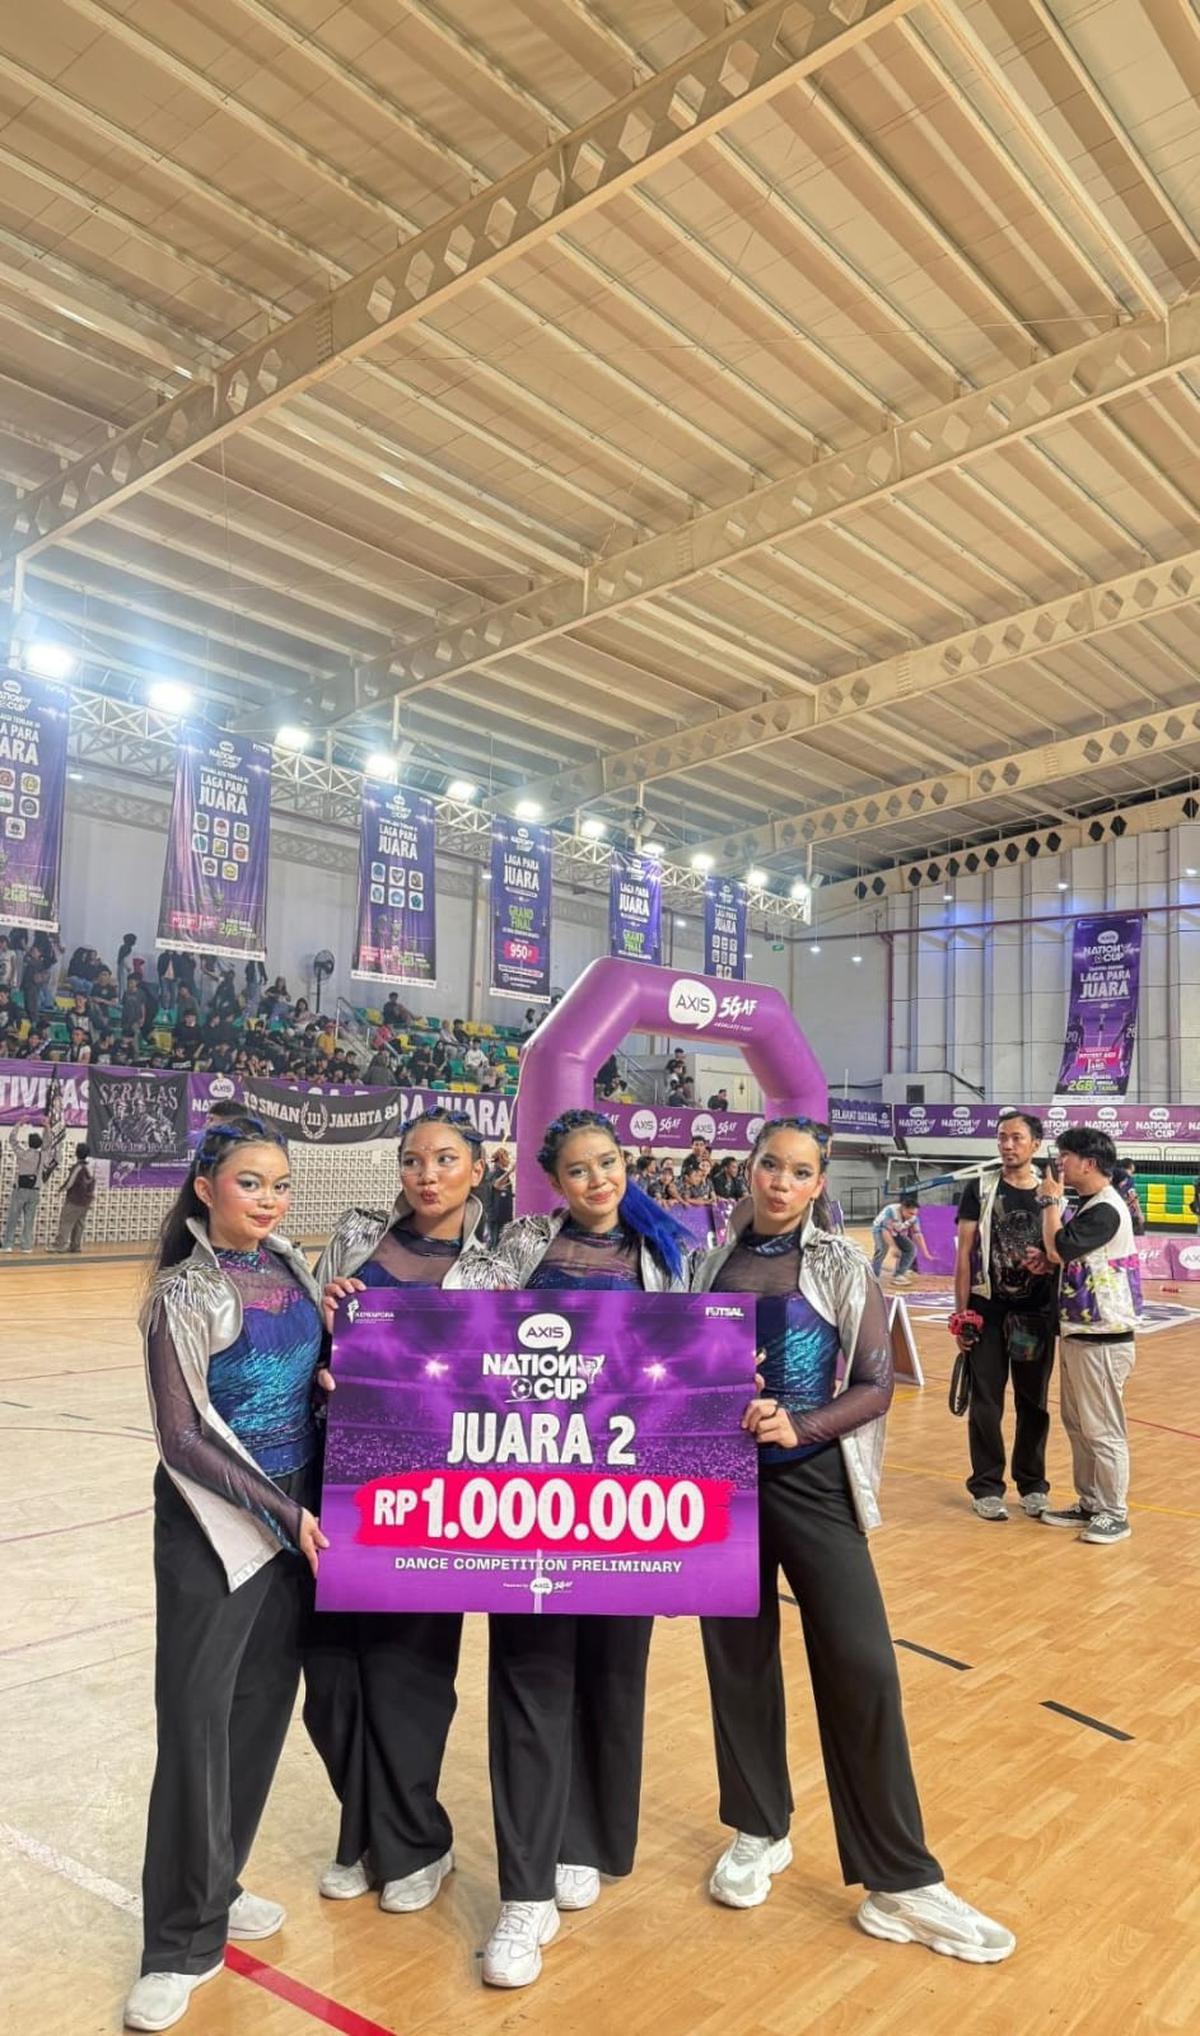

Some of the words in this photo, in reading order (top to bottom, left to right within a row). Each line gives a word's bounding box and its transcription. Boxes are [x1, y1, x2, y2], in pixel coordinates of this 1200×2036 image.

[10, 724, 39, 743] PARA
[0, 736, 39, 766] ARA
[201, 772, 224, 790] LAGA
[225, 780, 248, 796] PARA
[199, 785, 248, 816] JUARA
[380, 824, 398, 837] LAGA
[379, 834, 418, 860] JUARA
[504, 865, 540, 891] JUARA
[619, 893, 650, 917] JUARA
[1080, 972, 1104, 982] LAGA
[1107, 969, 1131, 981] PARA
[1080, 980, 1129, 998] JUARA
[676, 994, 710, 1013] AXIS
[258, 1099, 300, 1123] SMAN
[329, 1109, 382, 1128] JAKARTA
[1155, 1129, 1176, 1138] CUP
[705, 1306, 745, 1317] FUTSAL
[526, 1326, 564, 1338] AXIS
[482, 1353, 577, 1377] NATION
[533, 1377, 588, 1401] CUP
[447, 1412, 593, 1465] JUARA
[607, 1415, 637, 1466] 2
[395, 1557, 449, 1570] DANCE
[453, 1558, 568, 1571] COMPETITION
[572, 1559, 682, 1573] PRELIMINARY
